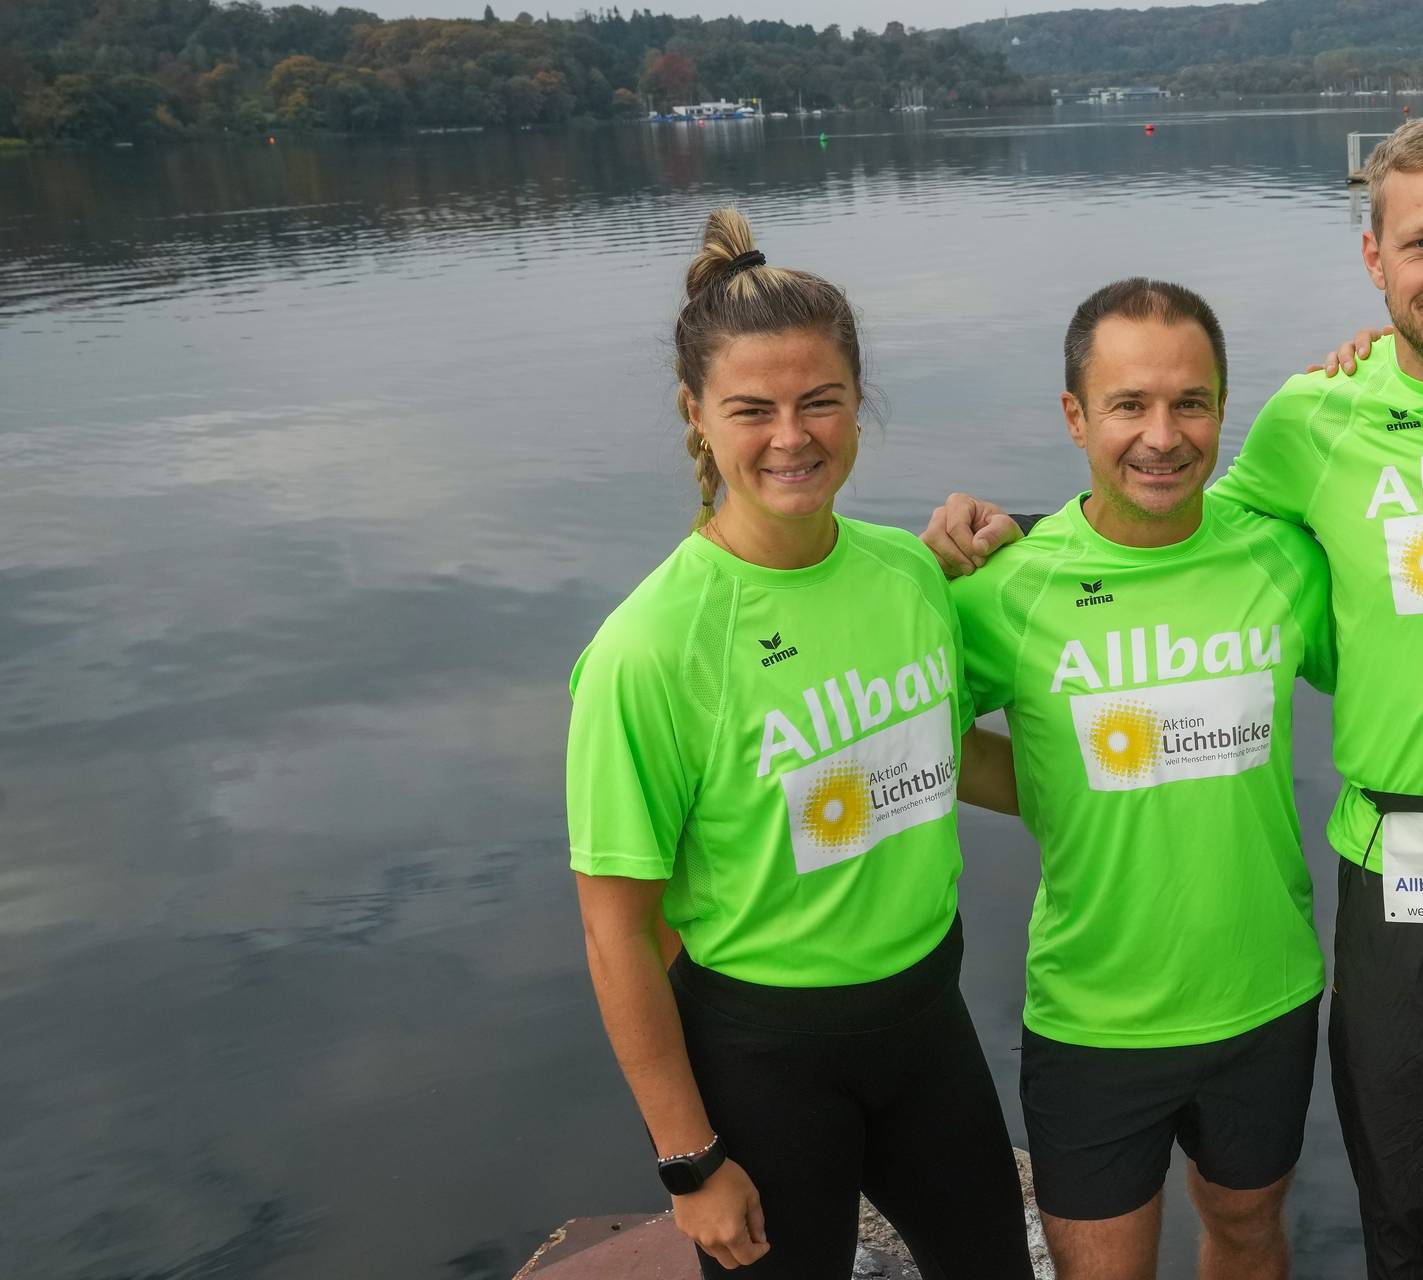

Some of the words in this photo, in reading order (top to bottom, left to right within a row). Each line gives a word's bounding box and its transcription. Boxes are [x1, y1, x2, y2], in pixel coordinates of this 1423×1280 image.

[1386, 418, 1421, 432] erima
[1075, 593, 1114, 608] erima
[761, 645, 799, 668] erima
[1050, 624, 1281, 693] Allbau
[757, 647, 951, 778] Allbau
[1162, 716, 1205, 732] Aktion
[1162, 722, 1270, 754] Lichtblicke
[1181, 754, 1217, 764] Menschen
[869, 761, 908, 786] Aktion
[890, 798, 924, 815] Menschen
